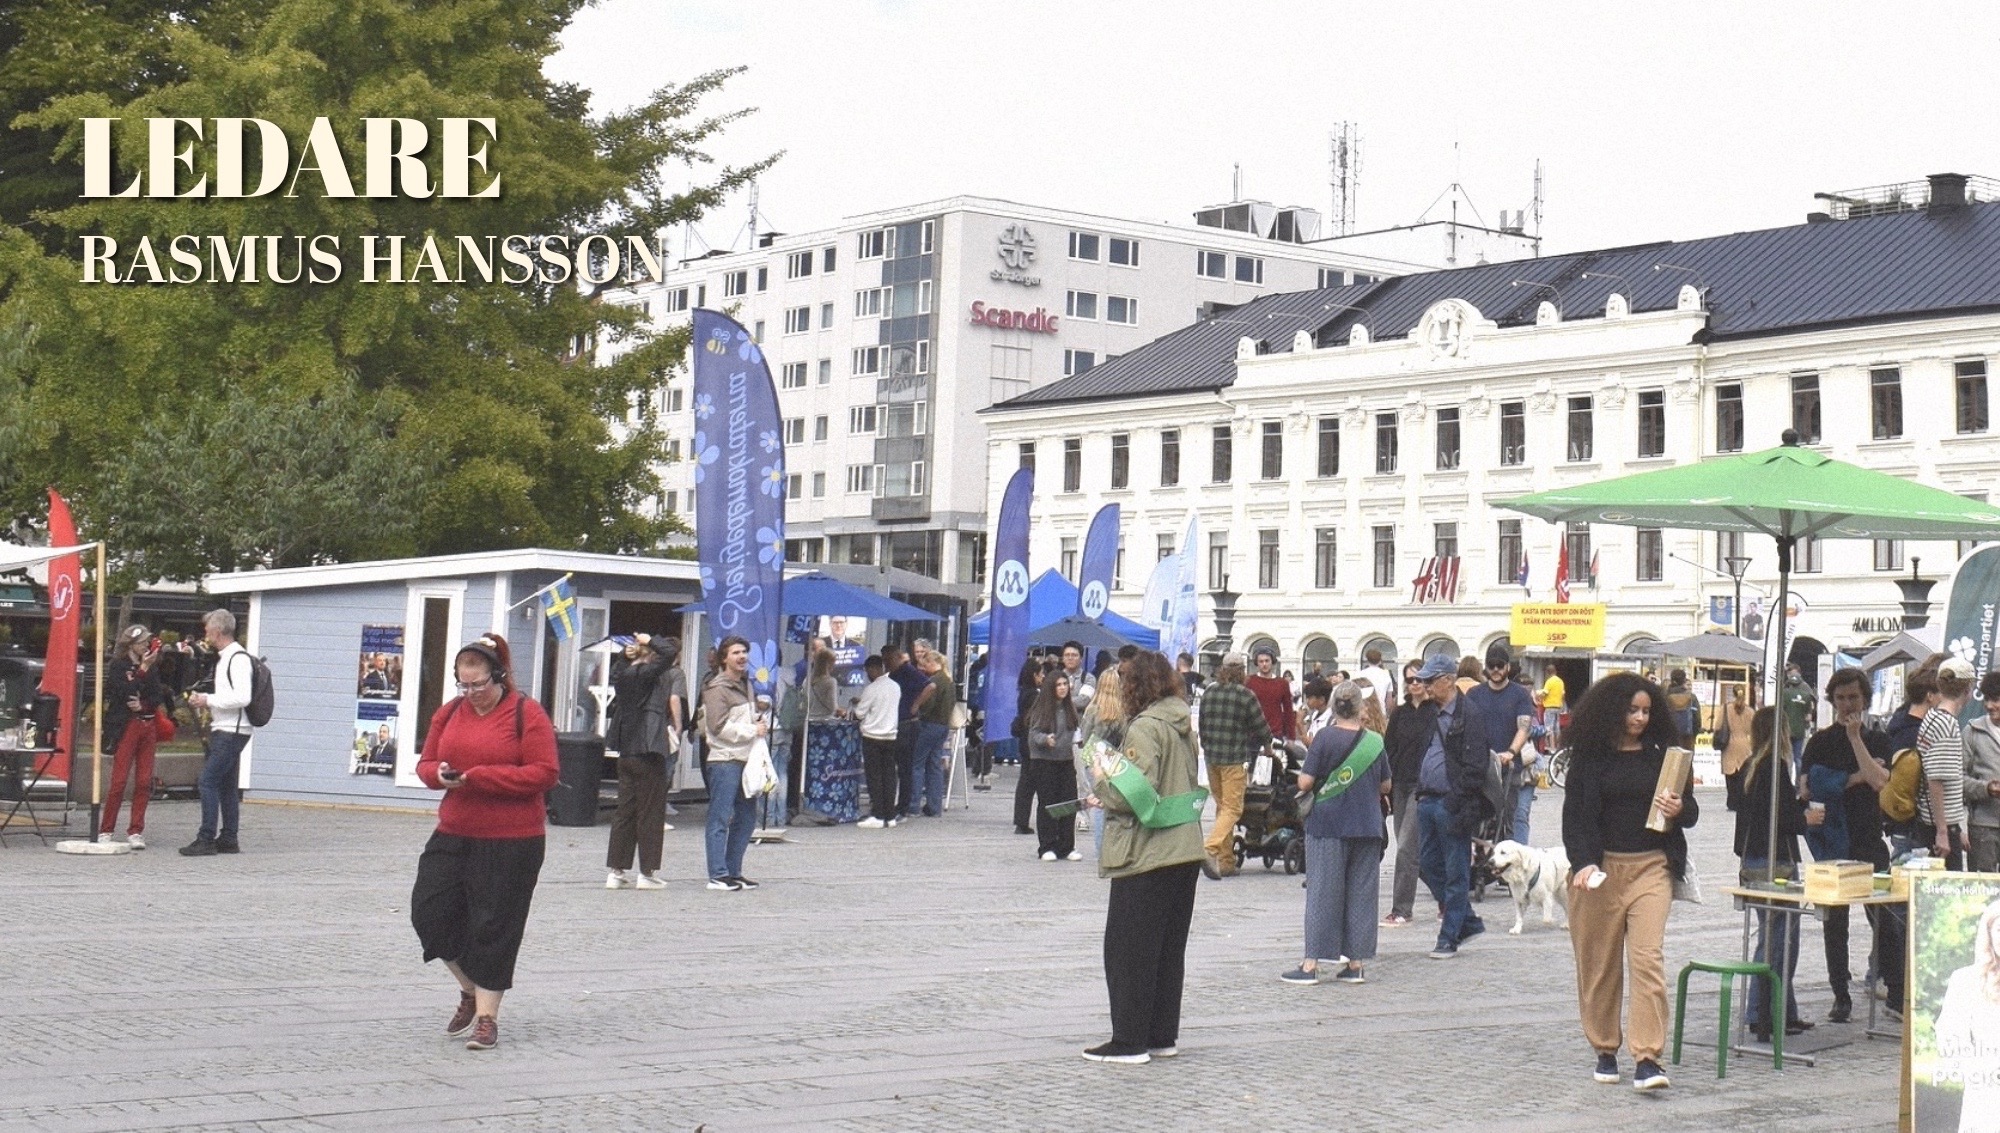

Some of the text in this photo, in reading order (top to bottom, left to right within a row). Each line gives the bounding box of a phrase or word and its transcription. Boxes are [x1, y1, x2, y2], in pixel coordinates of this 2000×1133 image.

[971, 300, 1059, 332] Scandic
[1411, 555, 1461, 605] H&M
[1580, 607, 1595, 616] RÖST
[1523, 617, 1541, 625] STÄRK
[1871, 616, 1905, 632] HOM
[1552, 633, 1567, 641] SKP
